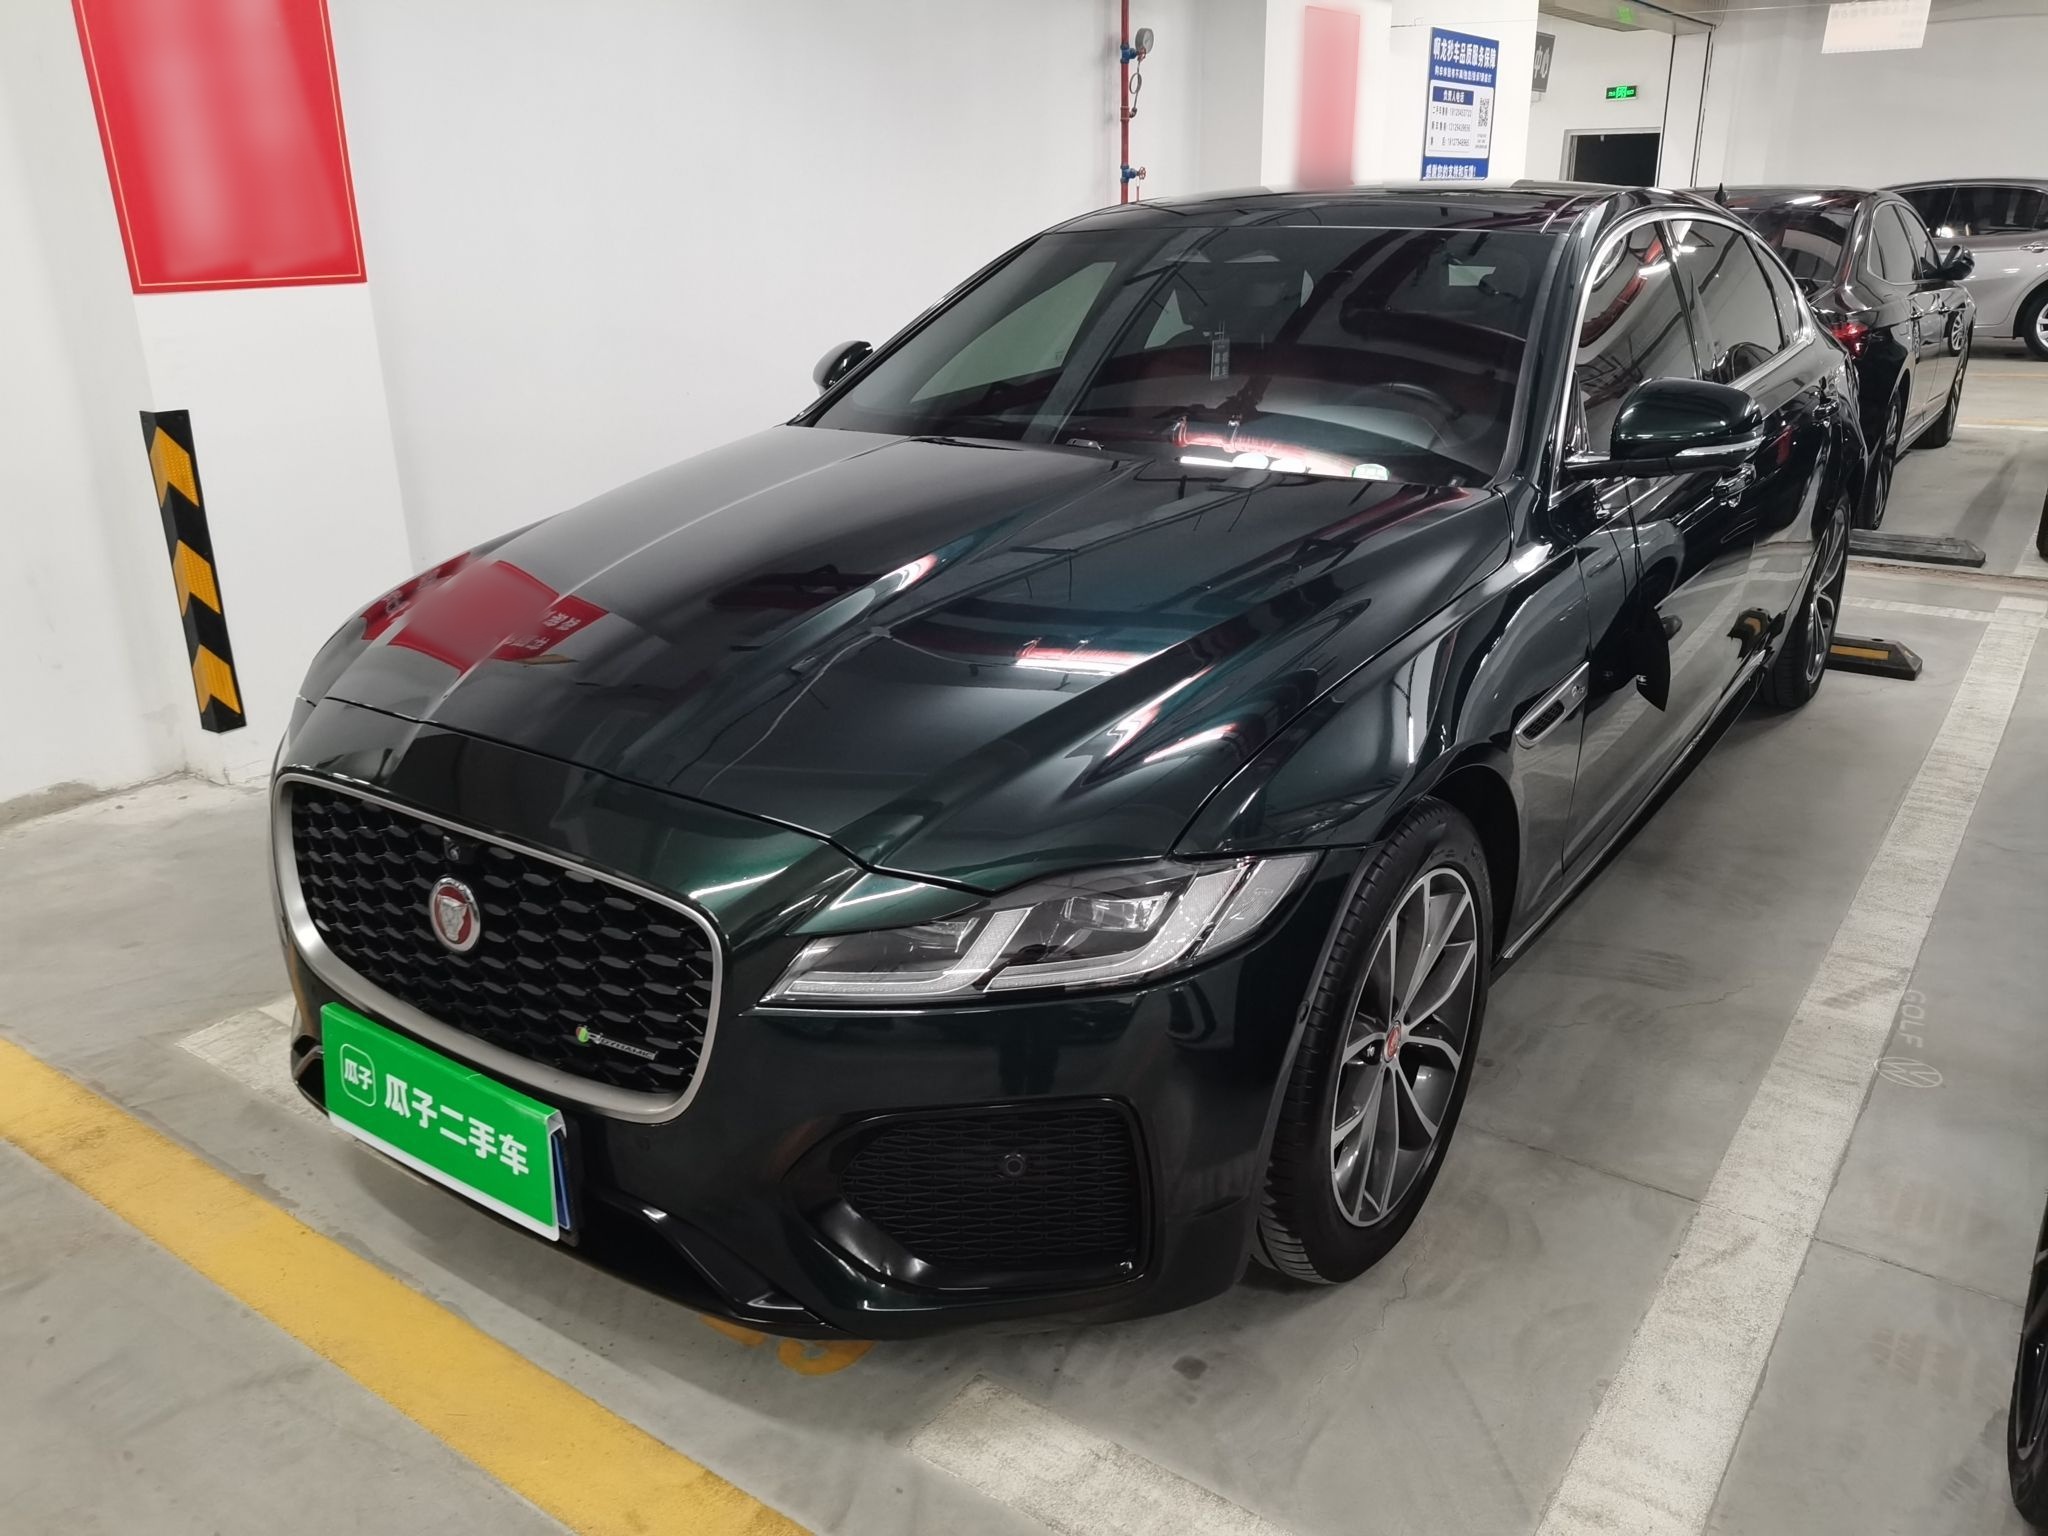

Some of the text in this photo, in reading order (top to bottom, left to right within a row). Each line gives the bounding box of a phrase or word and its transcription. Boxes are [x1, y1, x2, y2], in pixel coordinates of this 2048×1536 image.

[1899, 990, 1926, 1048] GOLF
[344, 1058, 373, 1091] 瓜子
[384, 1073, 530, 1176] 瓜子二手车
